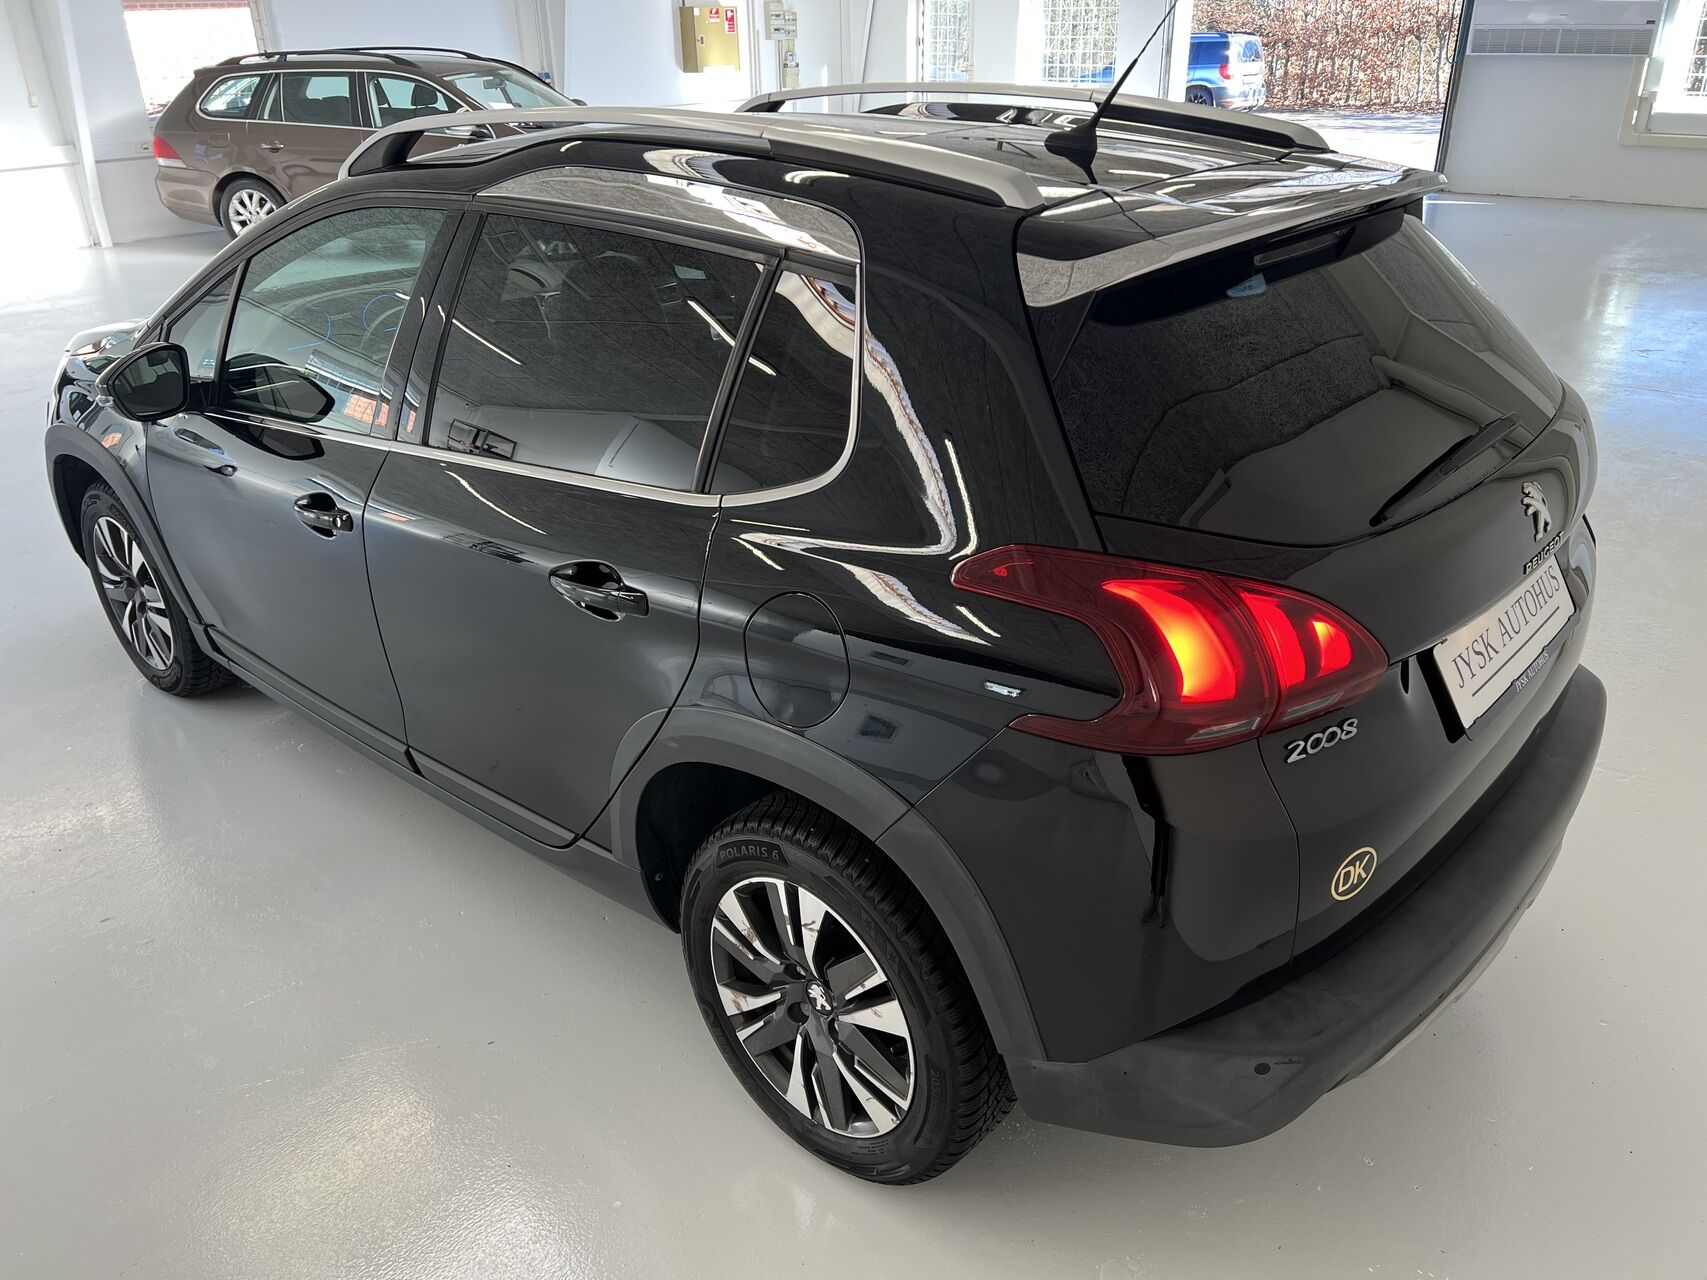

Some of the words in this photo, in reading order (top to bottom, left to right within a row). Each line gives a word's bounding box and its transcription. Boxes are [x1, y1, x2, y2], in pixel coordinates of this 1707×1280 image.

[1524, 530, 1564, 575] PEUGEOT
[1452, 628, 1499, 688] JYSK
[1498, 565, 1560, 648] AUTOHUS
[1515, 674, 1529, 693] JYSK
[1287, 718, 1358, 763] 2008
[720, 845, 769, 858] POLARIS
[772, 850, 779, 861] 6
[1338, 854, 1371, 893] DK
